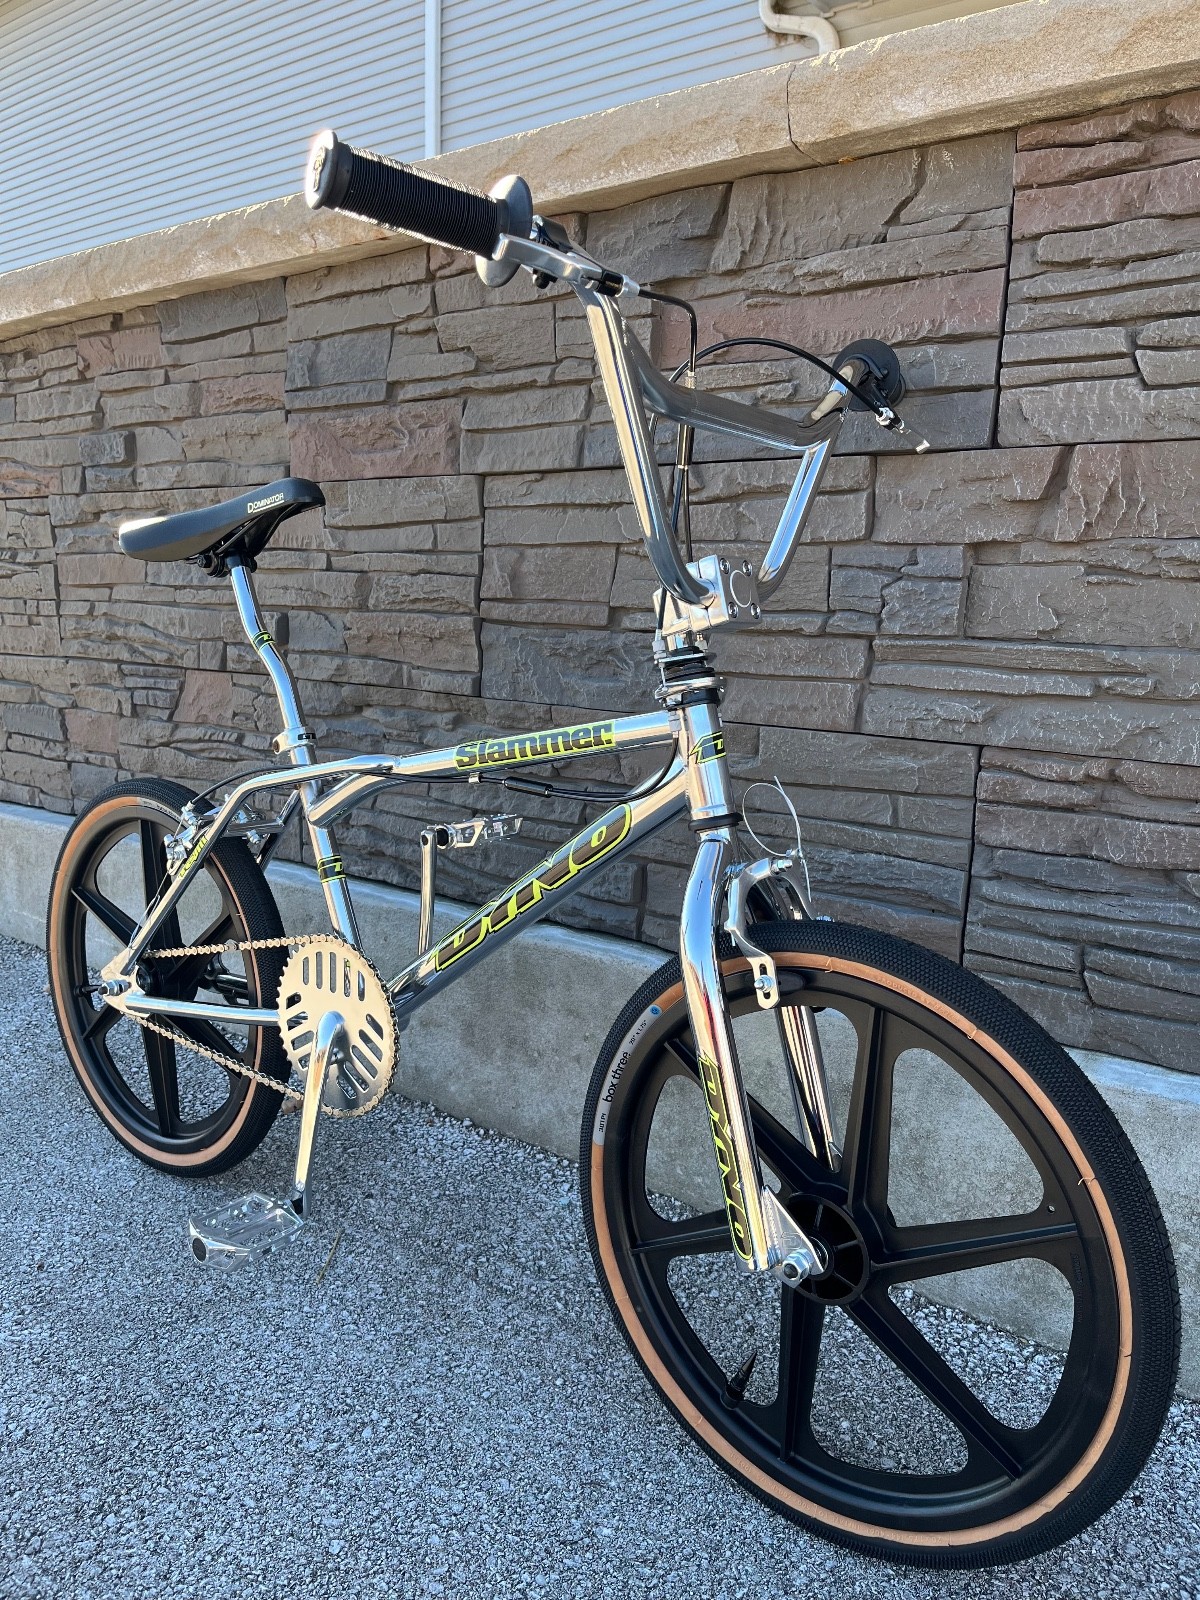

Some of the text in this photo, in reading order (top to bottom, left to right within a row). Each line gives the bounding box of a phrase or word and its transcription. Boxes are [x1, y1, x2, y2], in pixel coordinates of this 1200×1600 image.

[247, 492, 284, 513] DOMINATOR
[425, 803, 632, 972] DYNO
[602, 1081, 618, 1103] box
[612, 1051, 629, 1080] three
[699, 1050, 753, 1260] DYNO
